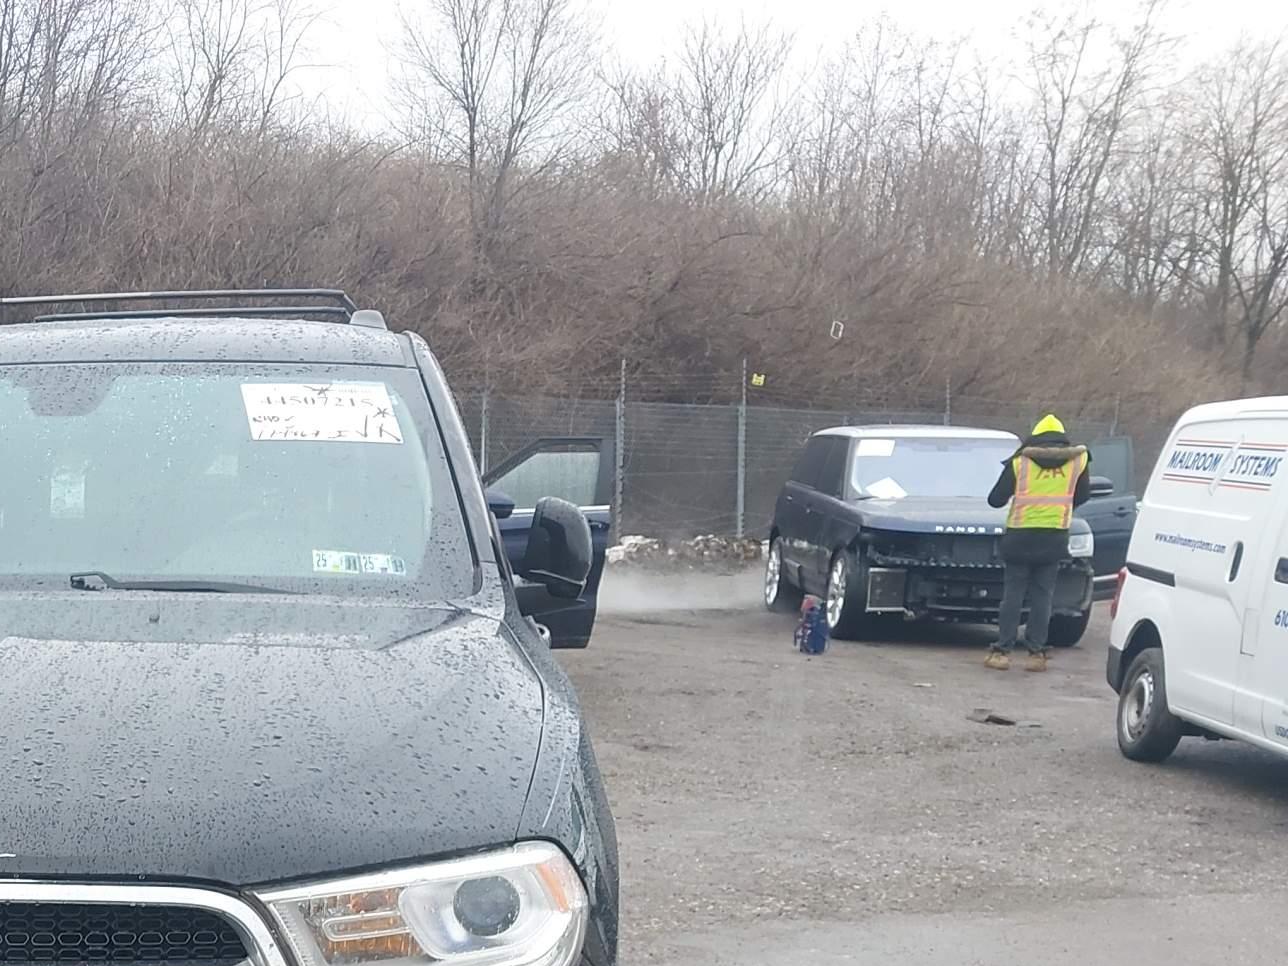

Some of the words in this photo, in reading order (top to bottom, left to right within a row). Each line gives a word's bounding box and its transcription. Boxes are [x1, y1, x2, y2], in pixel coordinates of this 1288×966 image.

[1167, 451, 1223, 473] MAILROOM
[1230, 455, 1283, 478] SYSTEMS
[935, 525, 986, 534] RANGE
